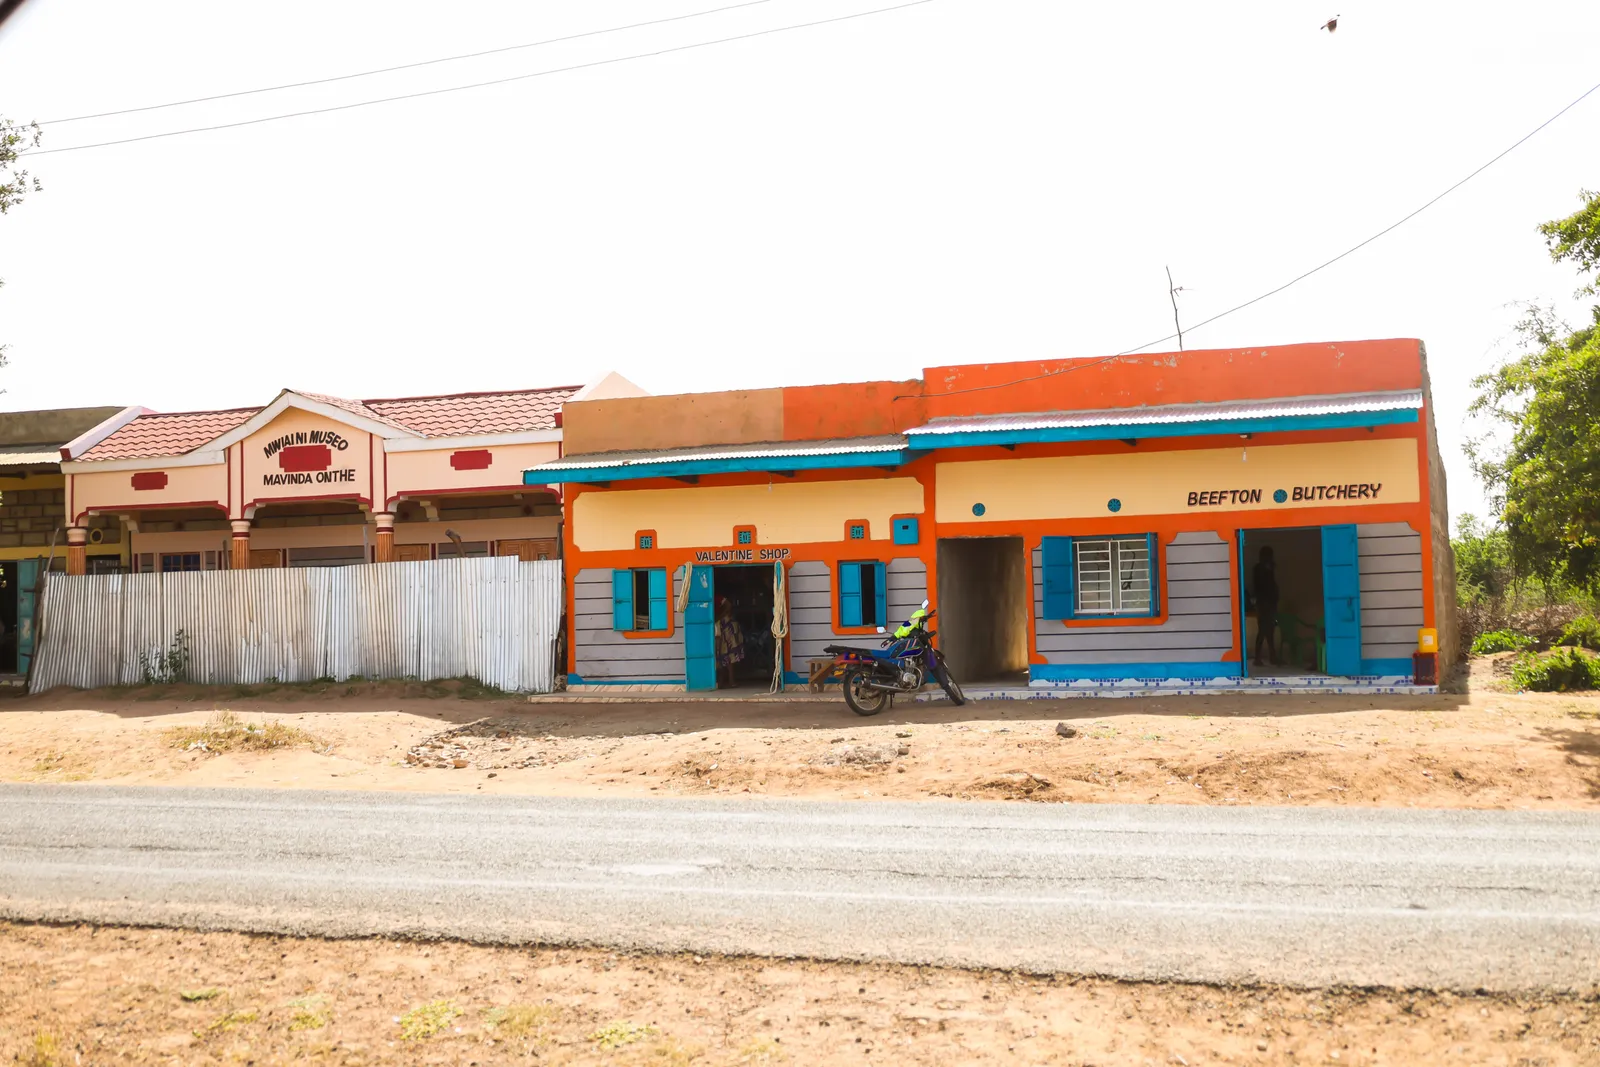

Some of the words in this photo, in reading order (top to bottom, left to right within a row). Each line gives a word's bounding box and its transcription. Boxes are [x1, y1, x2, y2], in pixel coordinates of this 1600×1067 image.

[308, 430, 349, 451] MUSEO
[263, 472, 313, 486] MAVINDA
[315, 469, 356, 483] ONTHE
[1187, 489, 1263, 506] BEEFTON
[1292, 483, 1382, 501] BUTCHERY
[695, 549, 753, 562] VALENTINE
